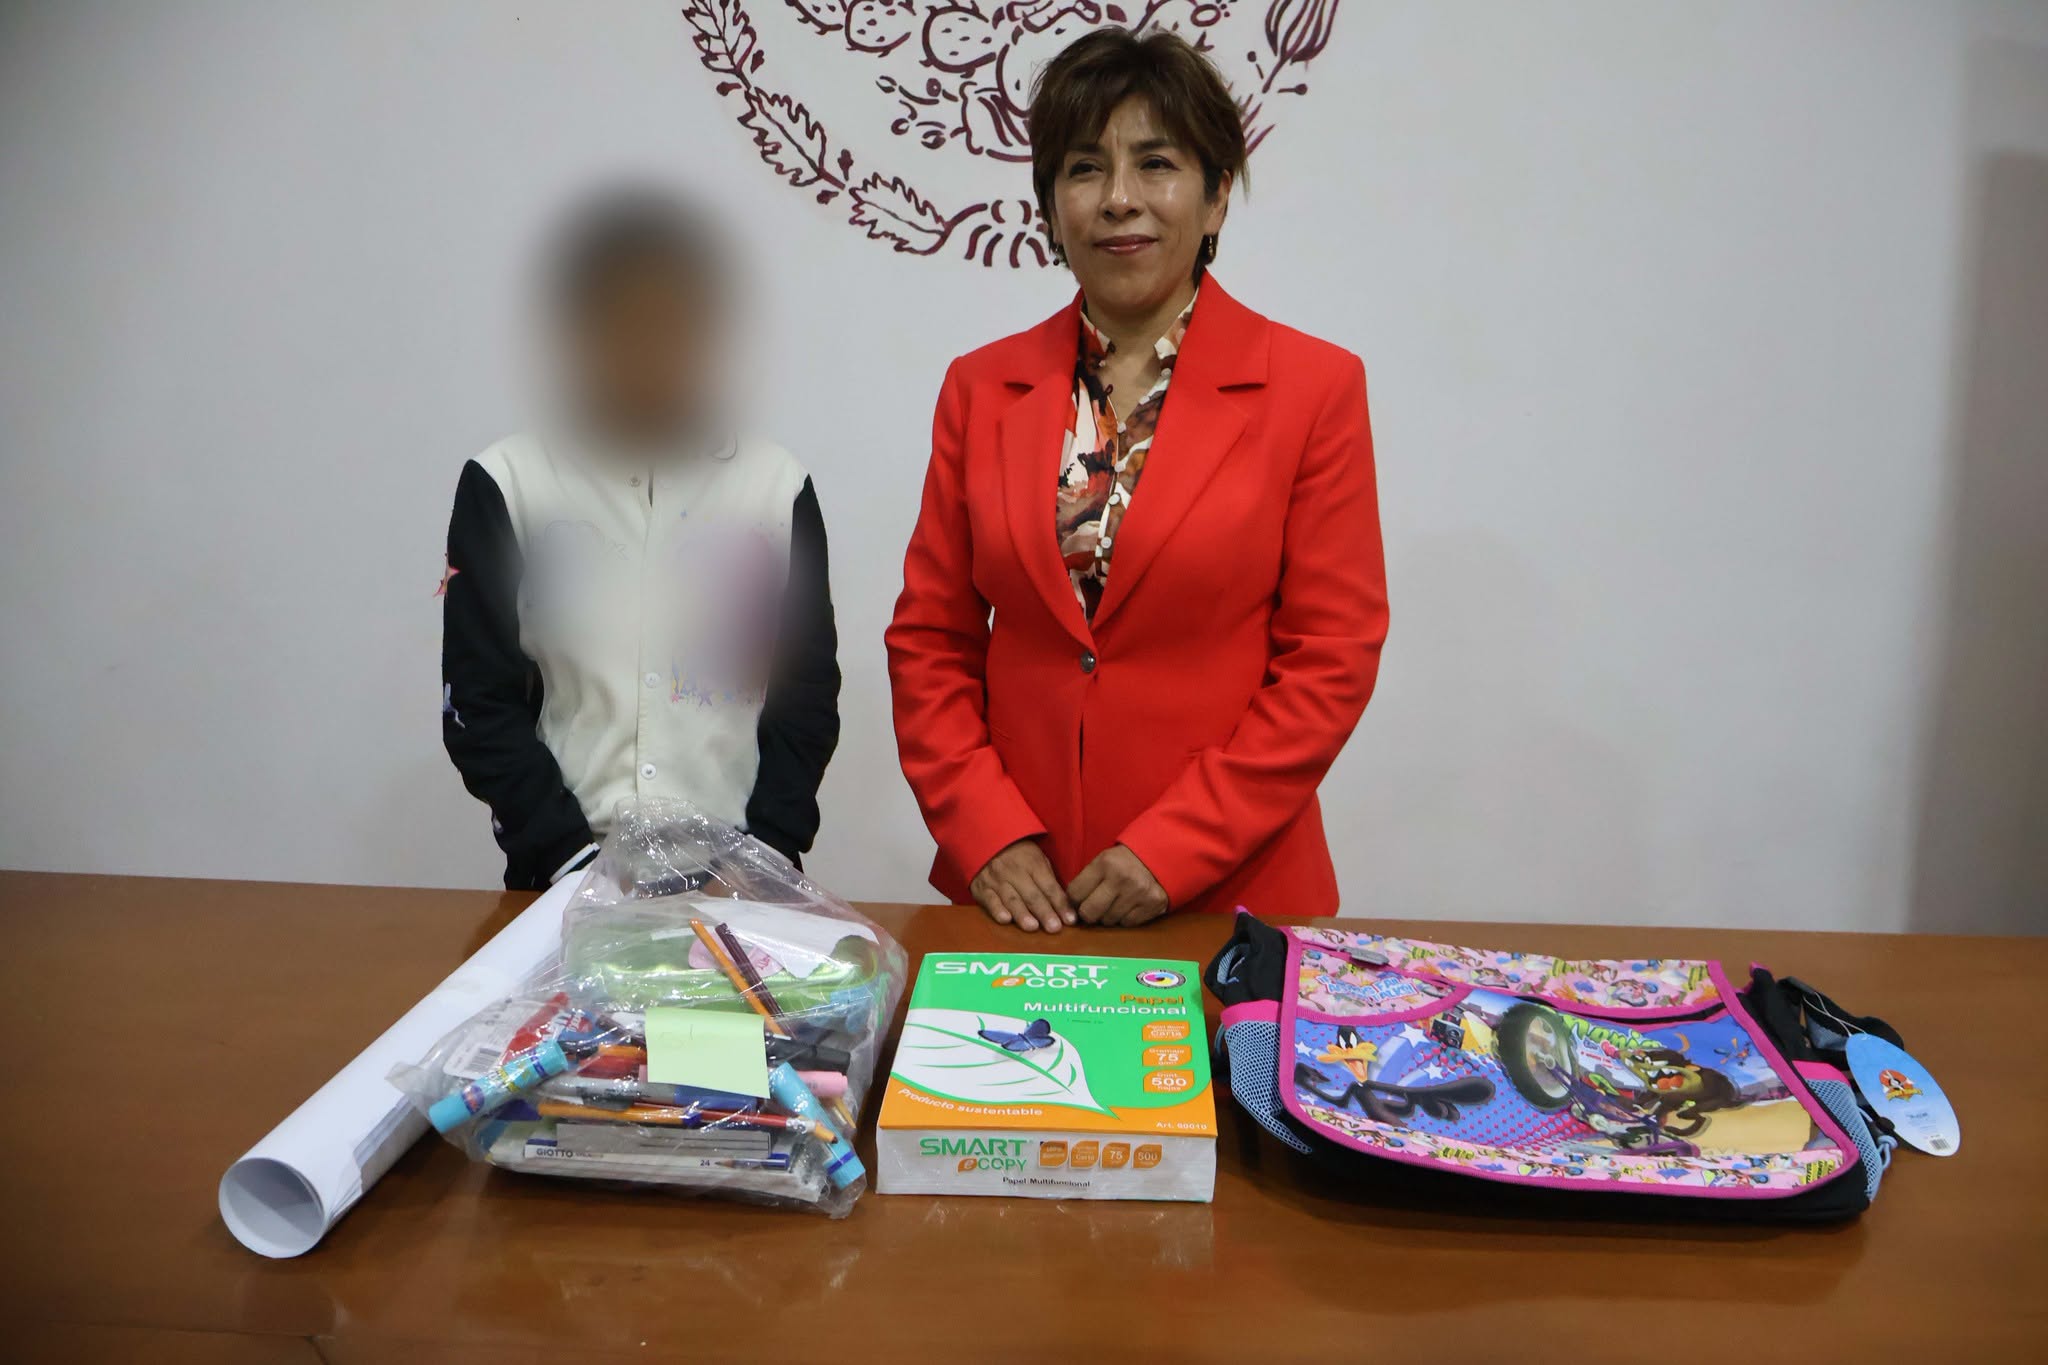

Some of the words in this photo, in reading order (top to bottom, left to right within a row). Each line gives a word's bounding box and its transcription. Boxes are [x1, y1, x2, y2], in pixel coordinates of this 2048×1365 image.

[935, 961, 1108, 978] SMART
[1120, 993, 1184, 1005] Papel
[1023, 1002, 1187, 1015] Multifuncional
[1158, 1054, 1178, 1062] 75
[1152, 1077, 1186, 1086] 500
[898, 1088, 955, 1110] Producto
[957, 1105, 1043, 1116] sustentable
[919, 1137, 1027, 1156] SMART
[536, 1148, 574, 1158] GIOTTO
[1109, 1150, 1123, 1160] 75
[1137, 1151, 1158, 1161] 500
[1002, 1176, 1027, 1185] Papel
[1029, 1178, 1090, 1187] Multifuncional
